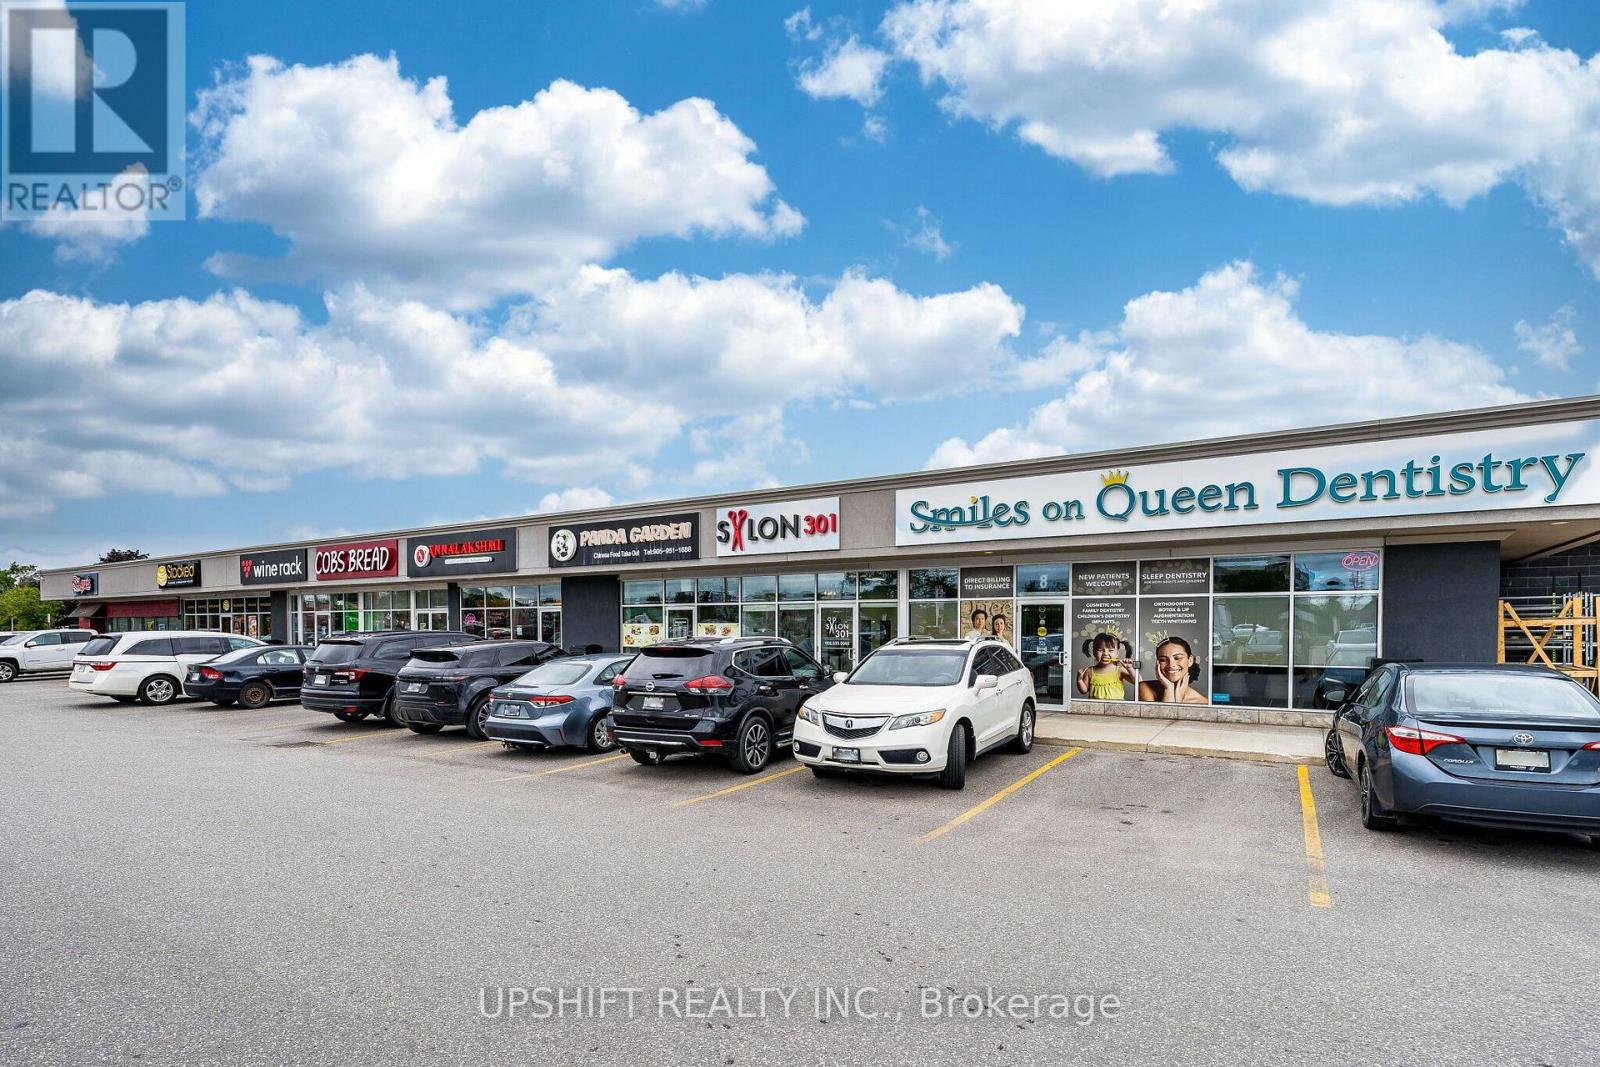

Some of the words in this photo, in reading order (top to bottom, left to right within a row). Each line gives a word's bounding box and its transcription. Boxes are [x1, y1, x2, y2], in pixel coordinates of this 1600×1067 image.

[909, 494, 1030, 533] Smiles
[1042, 499, 1085, 522] on
[1095, 480, 1259, 522] Queen
[1276, 452, 1586, 509] Dentistry
[580, 528, 627, 547] PANDA
[630, 521, 692, 543] GARDEN
[803, 513, 836, 535] 301
[315, 550, 345, 575] COBS
[347, 547, 389, 573] BREAD
[632, 549, 640, 557] Out
[1343, 555, 1376, 566] OPEN
[253, 560, 278, 578] wine
[279, 555, 302, 576] rack
[1040, 574, 1048, 589] 8
[835, 630, 849, 638] 301
